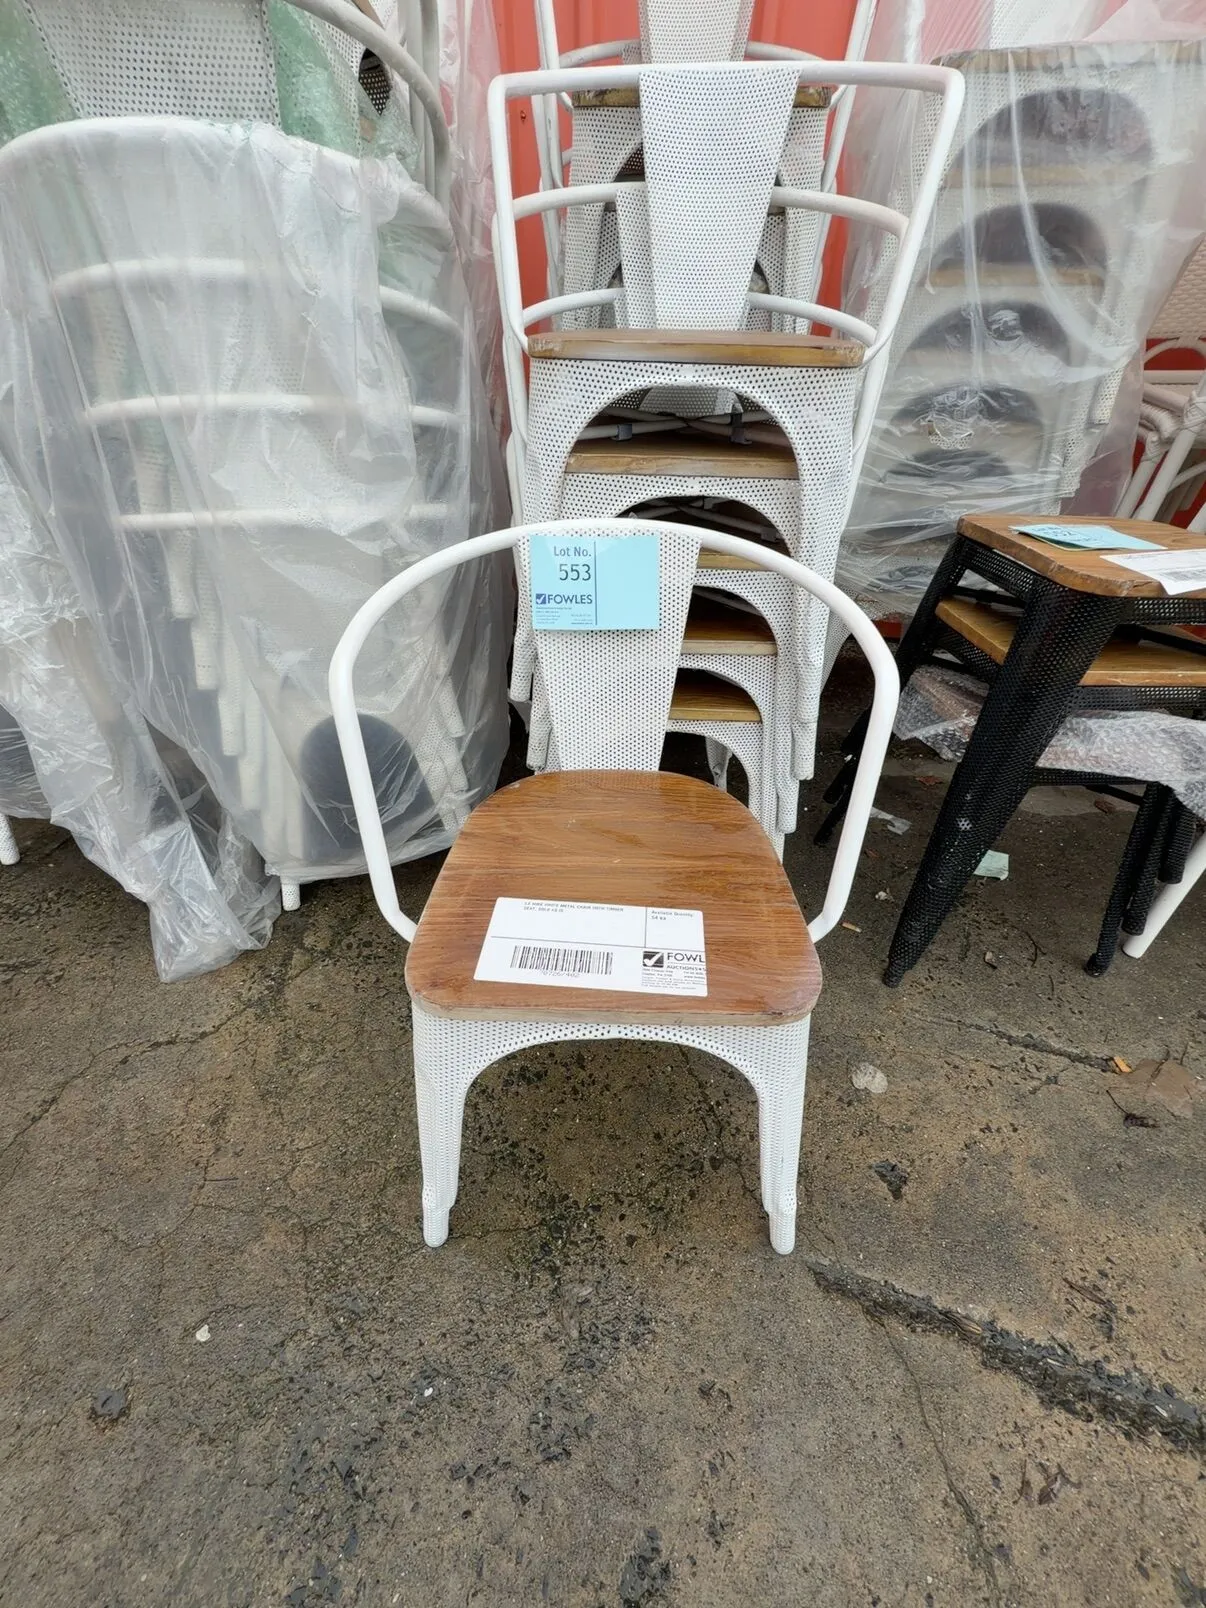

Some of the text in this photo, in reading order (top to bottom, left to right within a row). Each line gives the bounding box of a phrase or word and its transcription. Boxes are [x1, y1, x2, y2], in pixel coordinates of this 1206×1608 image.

[553, 546, 592, 557] Lot No.
[559, 563, 591, 581] 553
[547, 594, 593, 605] FOWLES
